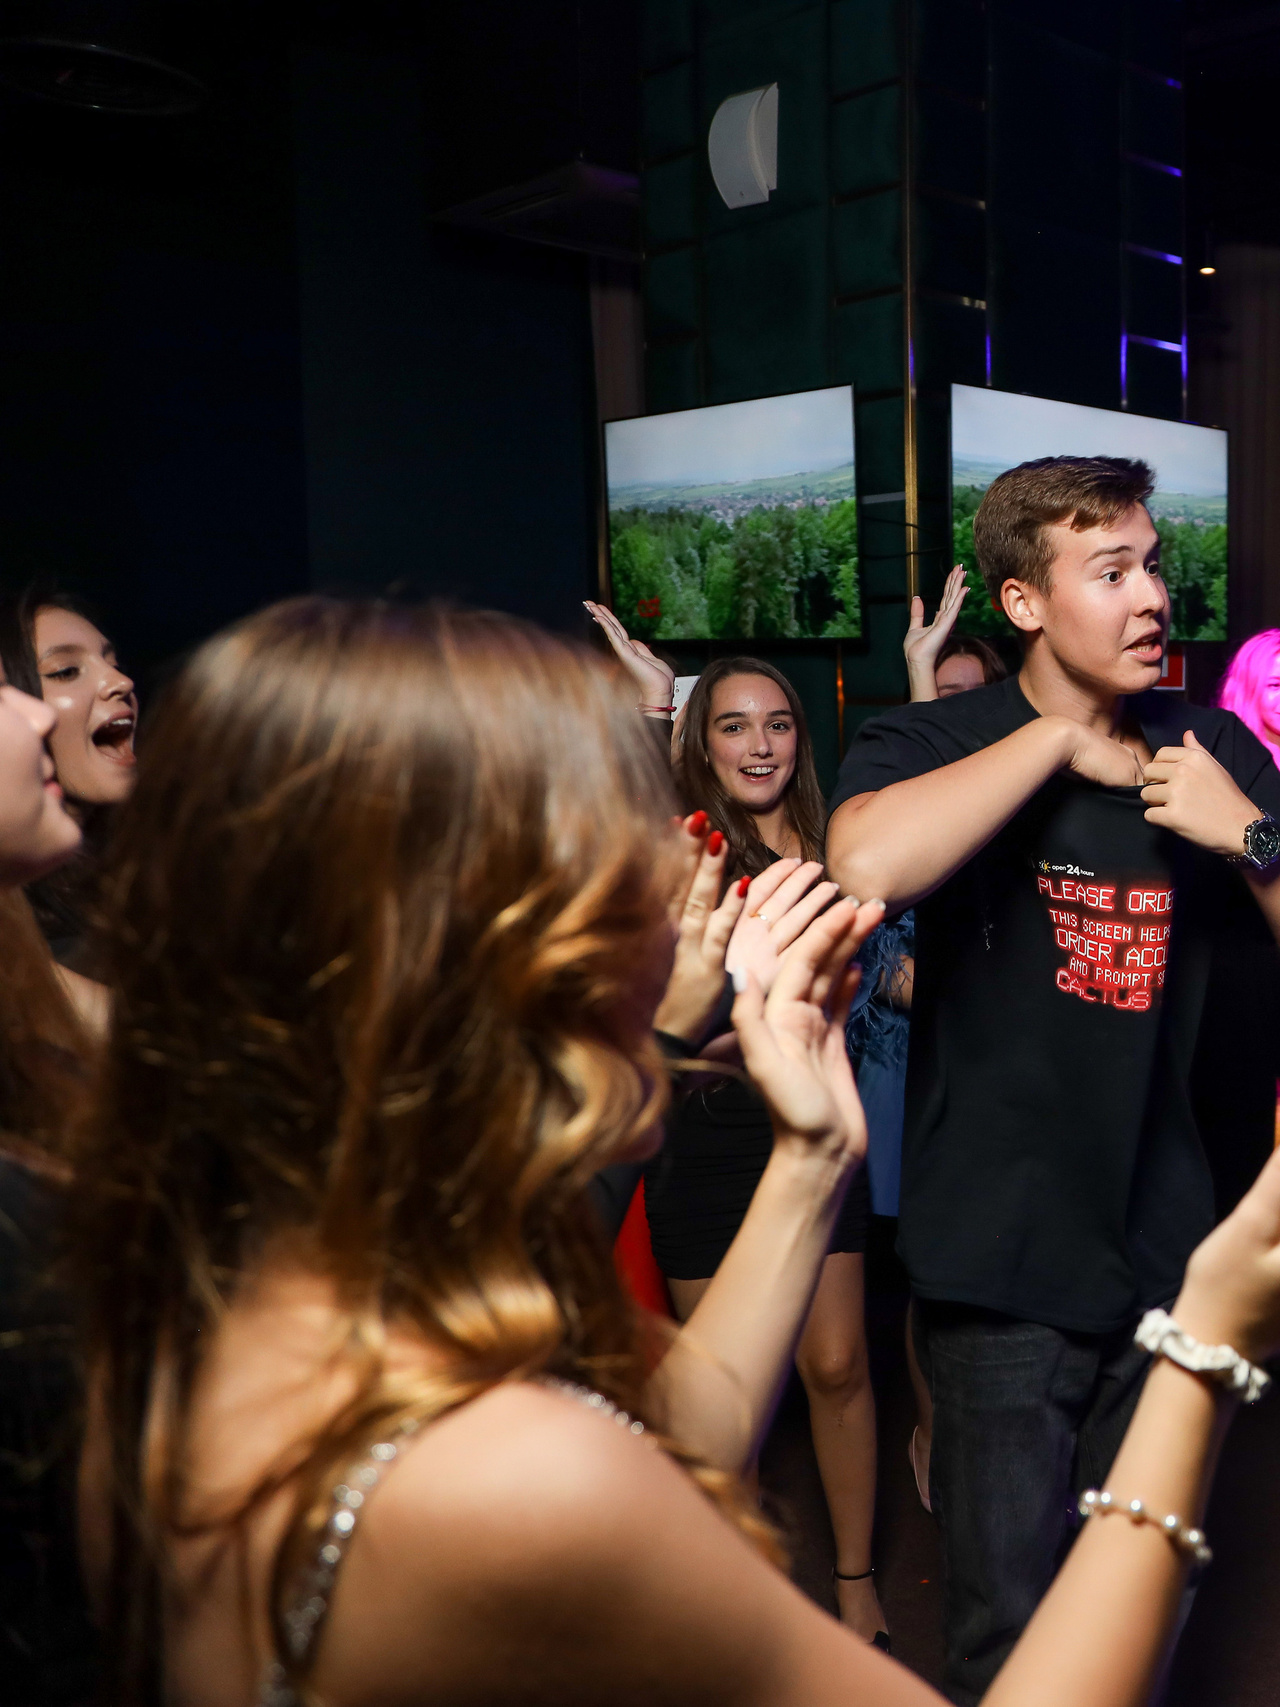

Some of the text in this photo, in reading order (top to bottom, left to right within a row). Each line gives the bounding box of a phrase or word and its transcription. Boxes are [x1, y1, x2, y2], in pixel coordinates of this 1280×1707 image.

[1066, 864, 1080, 876] 24
[1080, 869, 1095, 877] hours
[1037, 876, 1114, 910] PLEASE
[1049, 909, 1078, 928] THIS
[1082, 918, 1132, 941] SCREEN
[1056, 928, 1112, 964] ORDER
[1069, 956, 1088, 977] AND
[1095, 966, 1151, 987] PROMPT
[1056, 968, 1150, 1010] CACTUS
